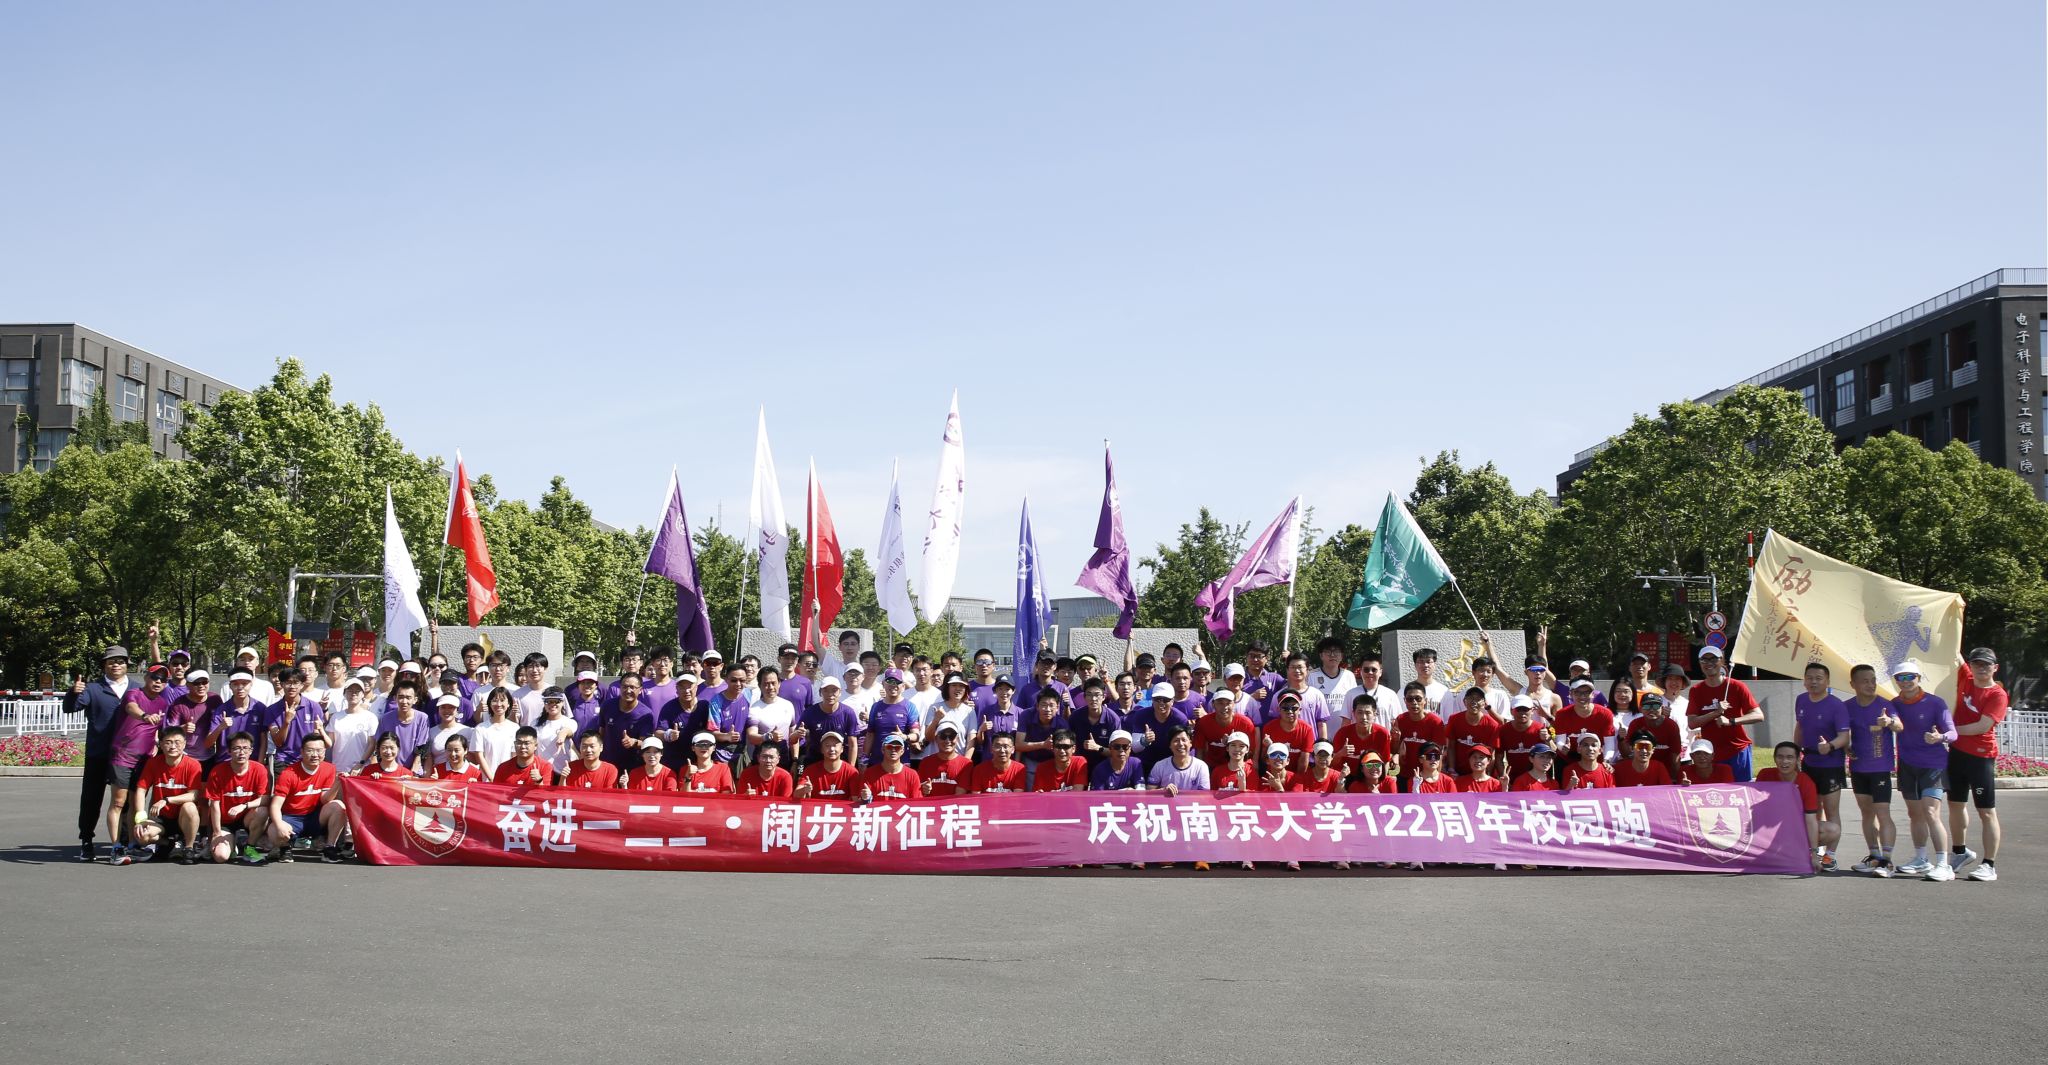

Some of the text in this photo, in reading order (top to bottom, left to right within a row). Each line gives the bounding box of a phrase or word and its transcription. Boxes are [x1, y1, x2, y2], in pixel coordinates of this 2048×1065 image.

[2015, 313, 2034, 473] 电子科学与工程学院
